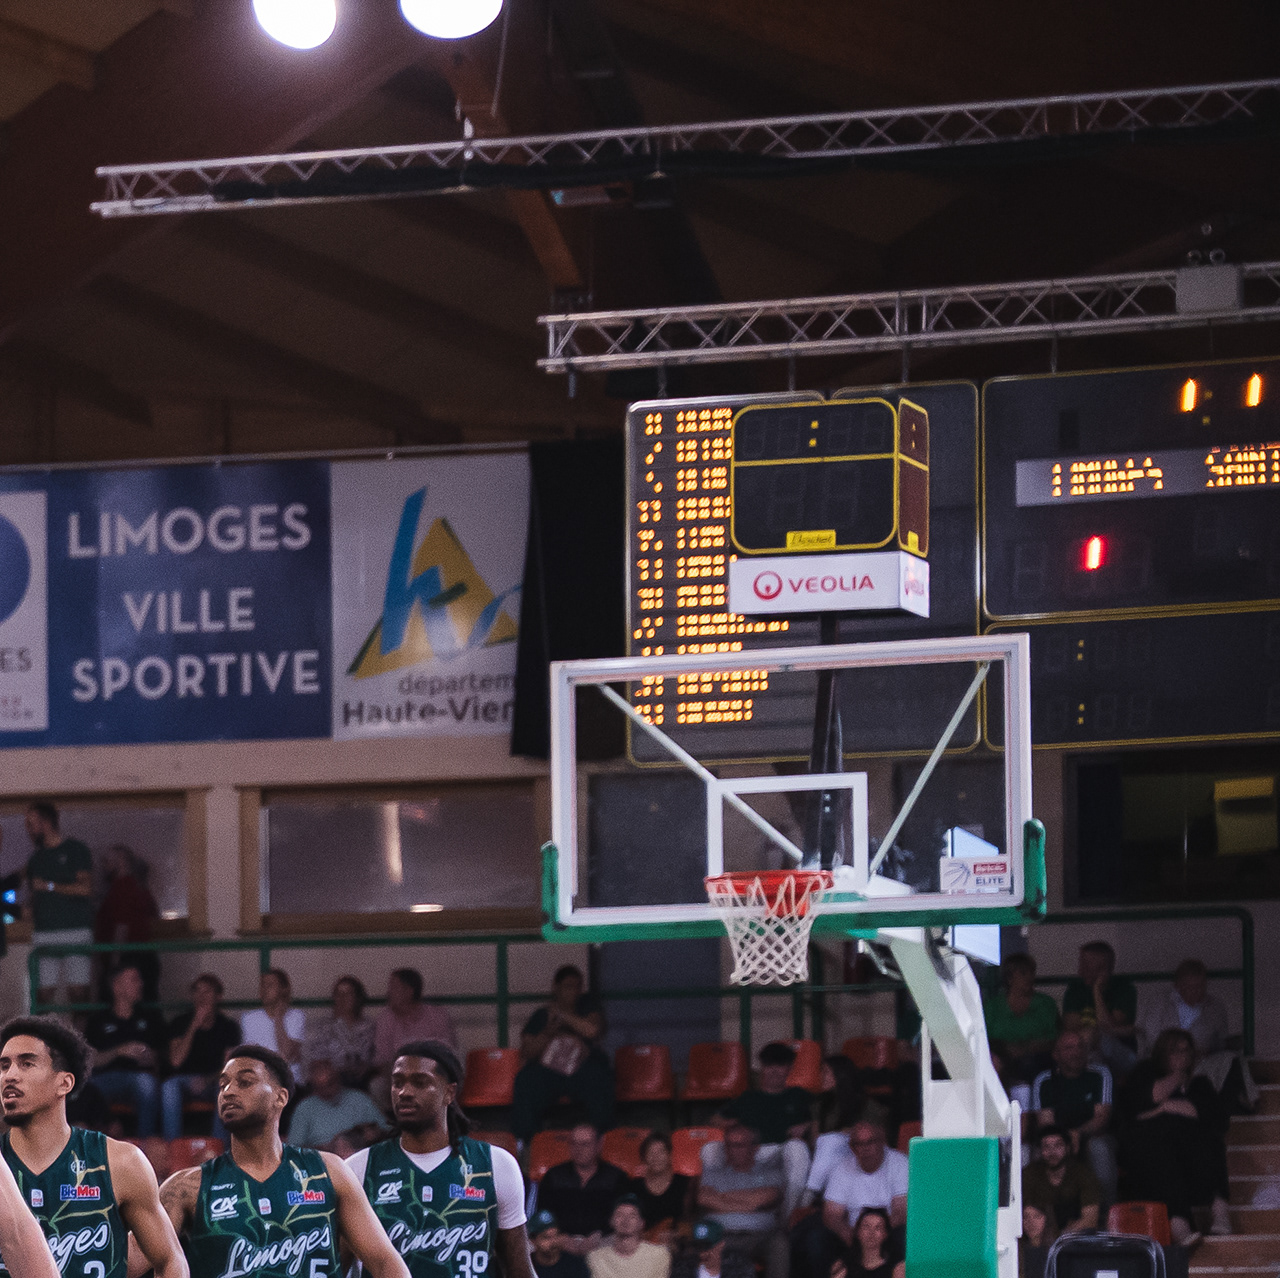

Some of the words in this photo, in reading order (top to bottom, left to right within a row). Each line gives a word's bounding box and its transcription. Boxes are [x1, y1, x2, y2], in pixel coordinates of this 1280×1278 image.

[68, 503, 312, 559] LIMOGES
[788, 575, 875, 593] VEOLIA
[123, 587, 256, 634] VILLE
[72, 650, 321, 701] SPORTIVE
[61, 1185, 101, 1200] BigMat
